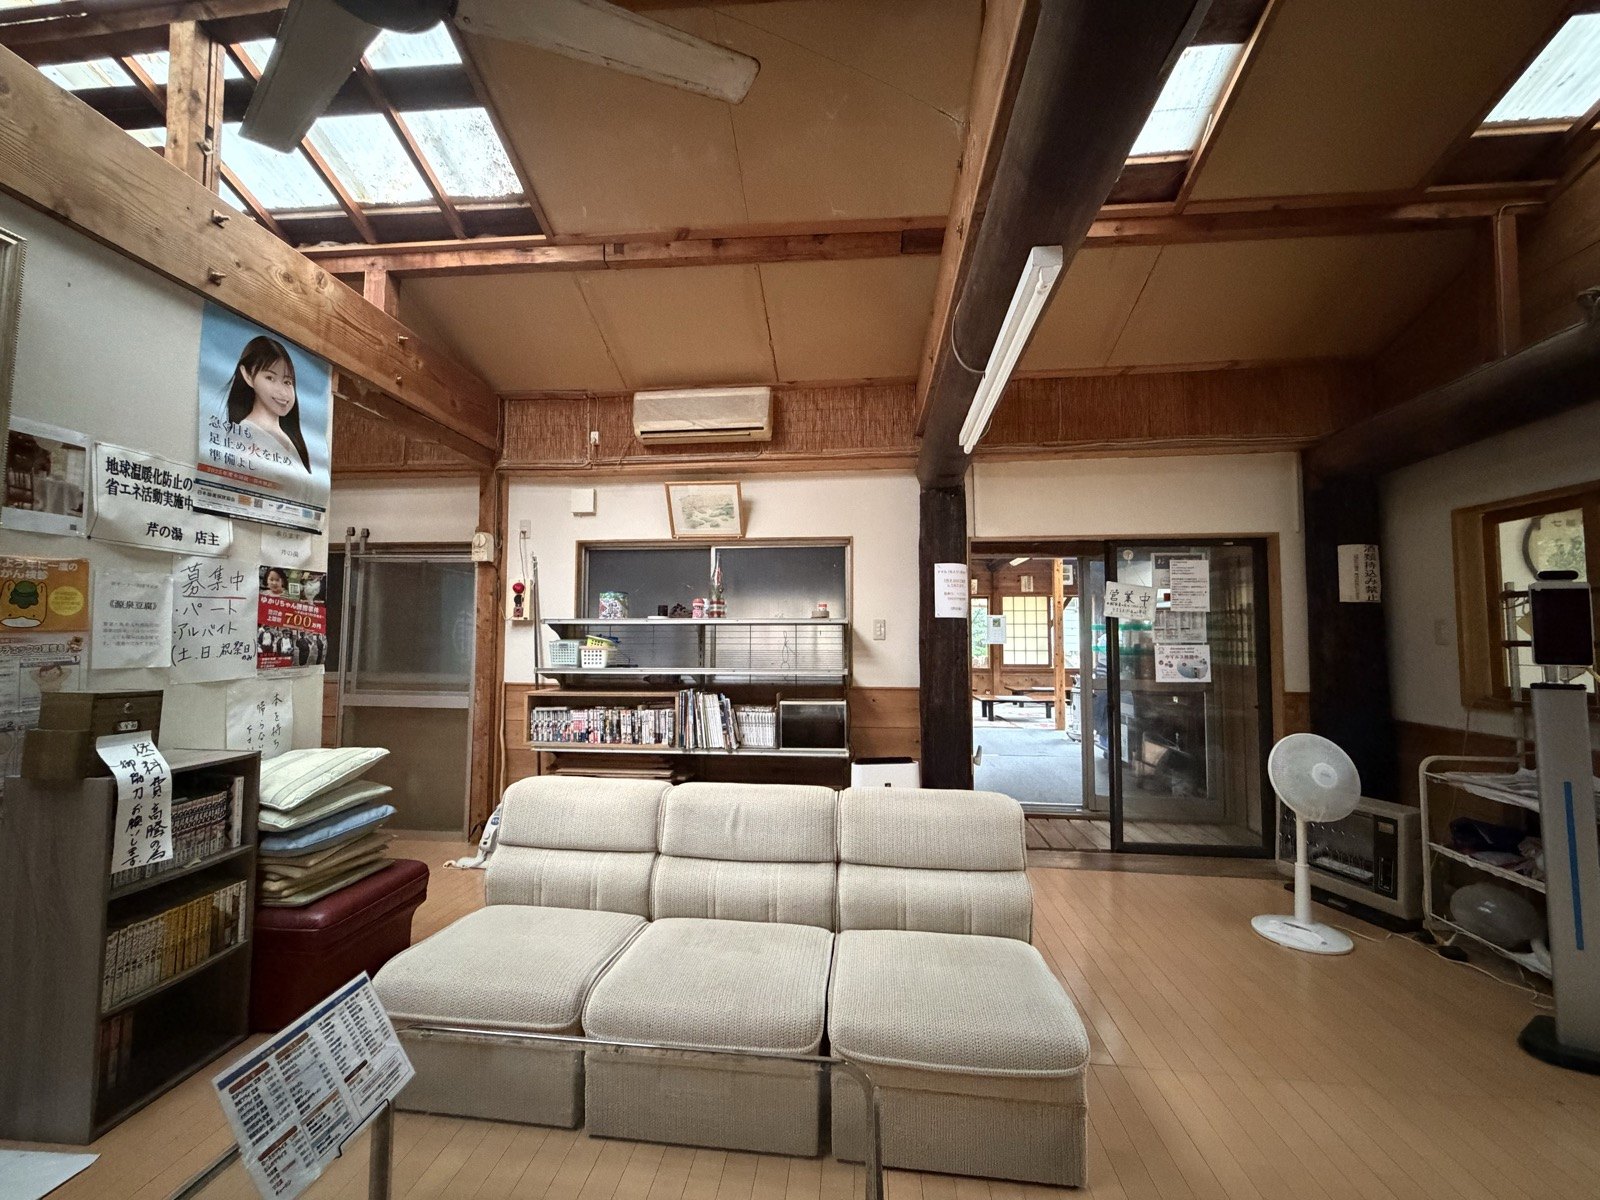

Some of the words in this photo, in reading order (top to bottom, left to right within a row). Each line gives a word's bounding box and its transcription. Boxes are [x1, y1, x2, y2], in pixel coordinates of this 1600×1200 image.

[209, 431, 292, 466] 足止め火を止め
[209, 448, 256, 471] 準備よし
[105, 456, 193, 491] 地球温暖化防止の
[105, 478, 194, 511] 省エネ活動実施中
[146, 521, 183, 541] 芹の湯
[195, 530, 220, 547] 店主
[180, 562, 245, 597] 募集中
